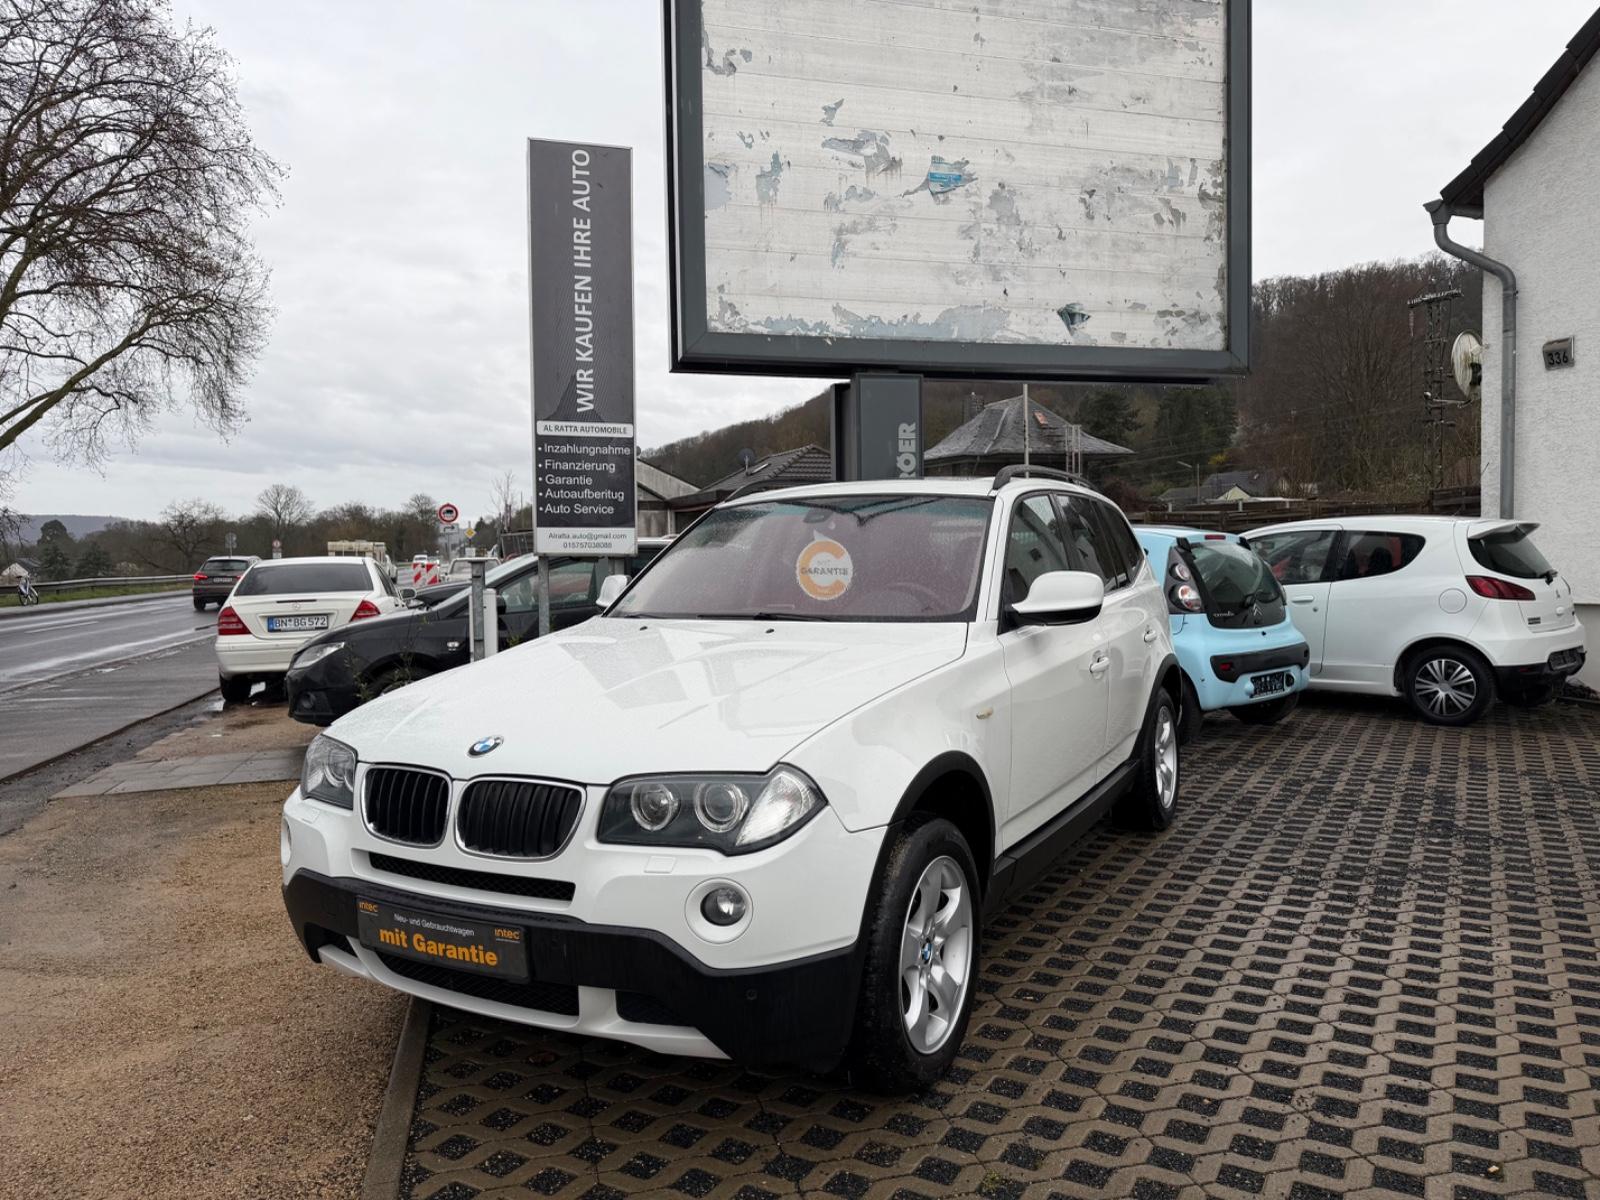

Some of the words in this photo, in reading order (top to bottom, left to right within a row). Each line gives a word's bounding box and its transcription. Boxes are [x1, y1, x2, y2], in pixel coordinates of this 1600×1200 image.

[571, 148, 592, 212] AUTO
[573, 216, 592, 268] IHRE
[574, 275, 594, 363] KAUFEN
[1547, 351, 1568, 366] 336
[576, 368, 595, 413] WIR
[543, 424, 554, 432] AL
[554, 424, 578, 433] RATTA
[579, 425, 628, 435] AUTOMOBILE
[544, 443, 631, 457] Inzahlungnahme
[544, 459, 616, 473] Finanzierung
[545, 474, 593, 485] Garantie
[544, 488, 625, 502] Autoaufberitug
[544, 503, 571, 514] Auto
[573, 504, 615, 515] Service
[274, 617, 288, 628] BN
[294, 616, 307, 627] BG
[307, 615, 326, 626] 572
[379, 927, 409, 947] mit
[412, 933, 498, 966] Garantie
